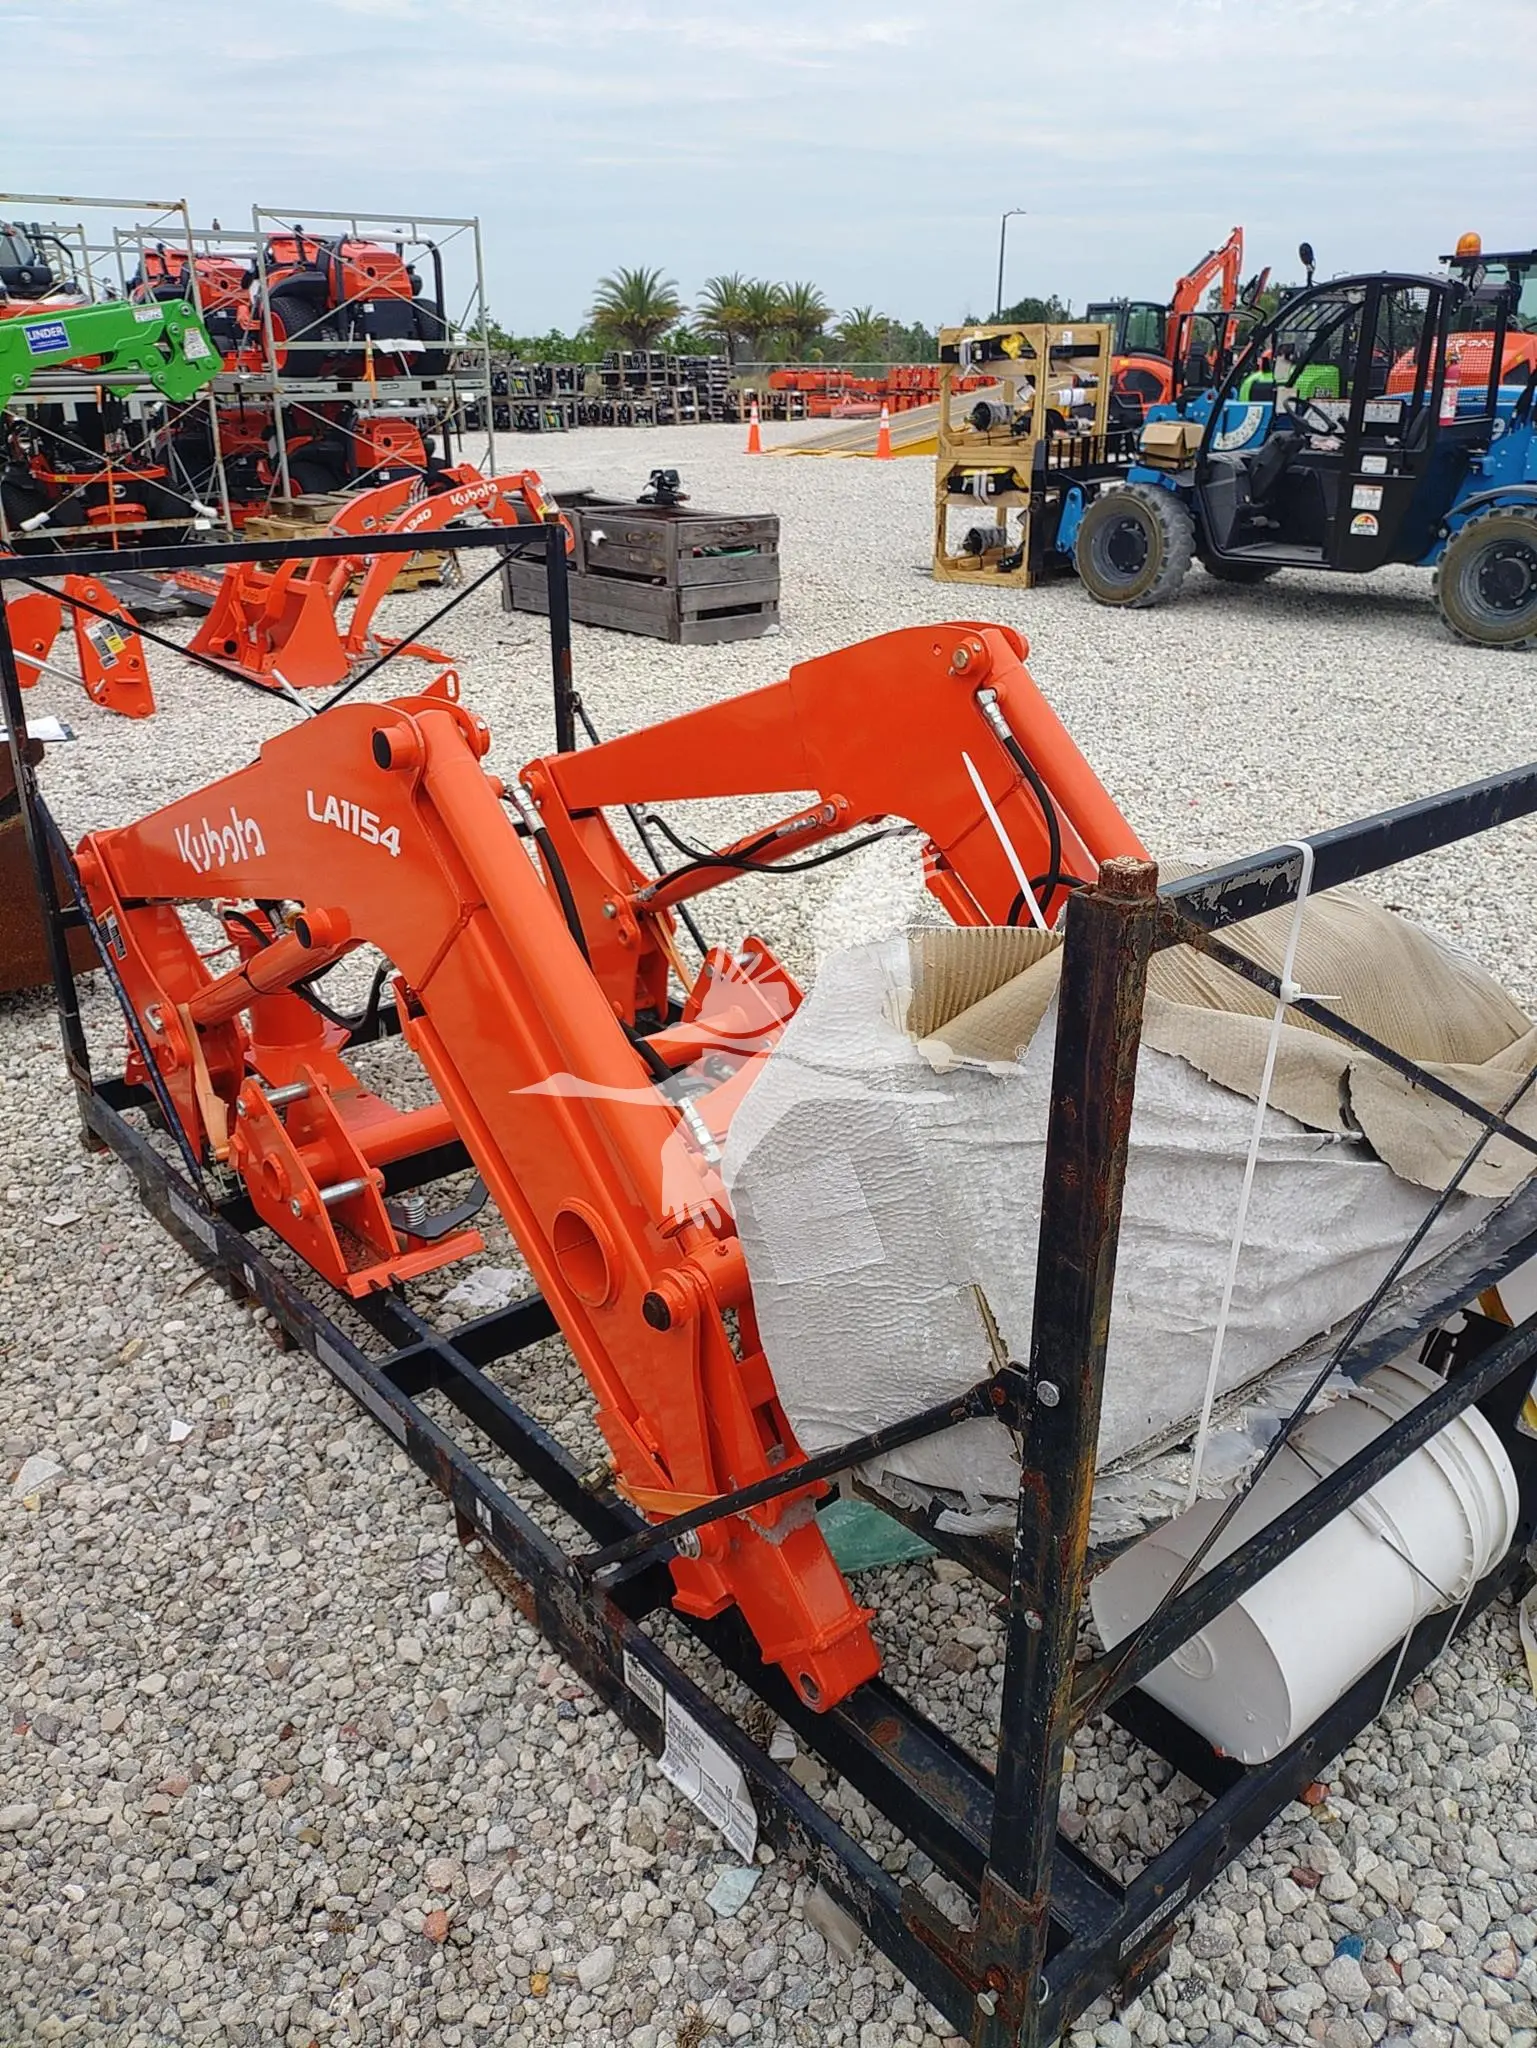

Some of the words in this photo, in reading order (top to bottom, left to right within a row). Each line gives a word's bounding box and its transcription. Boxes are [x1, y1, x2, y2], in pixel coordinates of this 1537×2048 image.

[449, 483, 498, 506] Kubota
[174, 806, 266, 874] Kubota
[306, 789, 401, 858] LA1154
